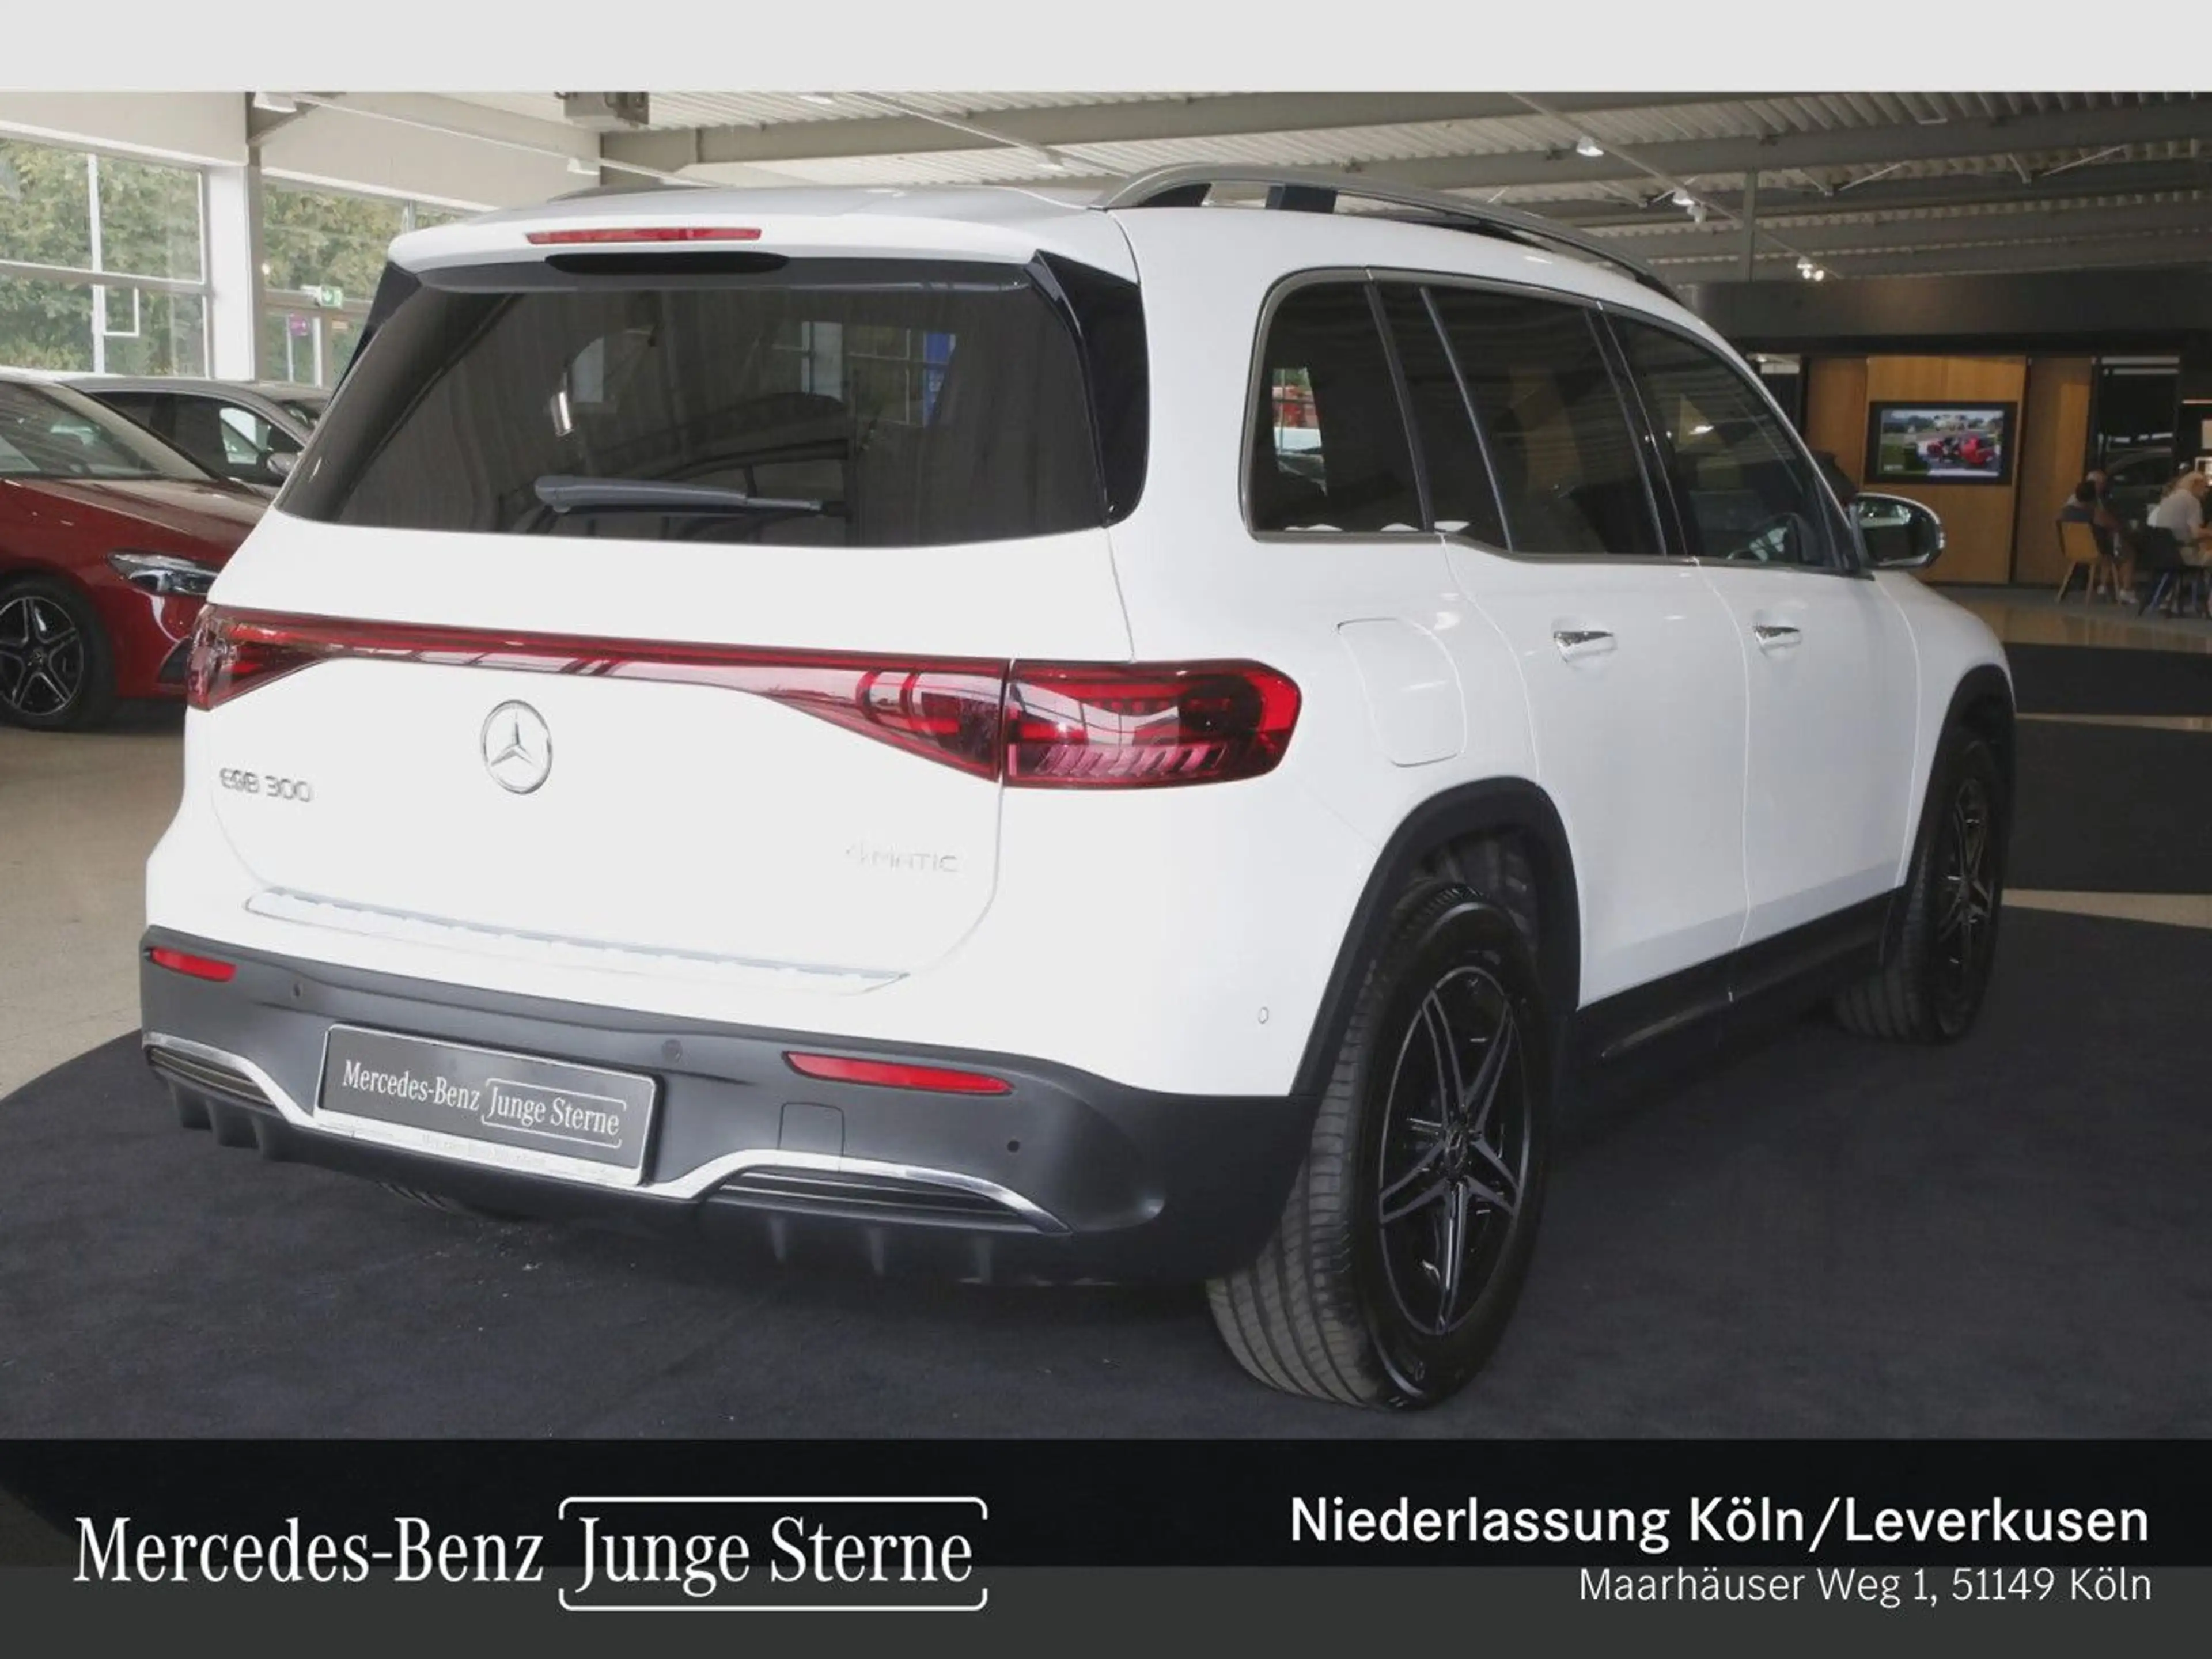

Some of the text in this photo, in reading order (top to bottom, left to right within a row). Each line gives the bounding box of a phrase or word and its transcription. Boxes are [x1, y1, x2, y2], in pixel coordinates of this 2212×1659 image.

[264, 775, 314, 802] 300
[342, 1059, 620, 1135] Mercedes-Benz Junge Sterne
